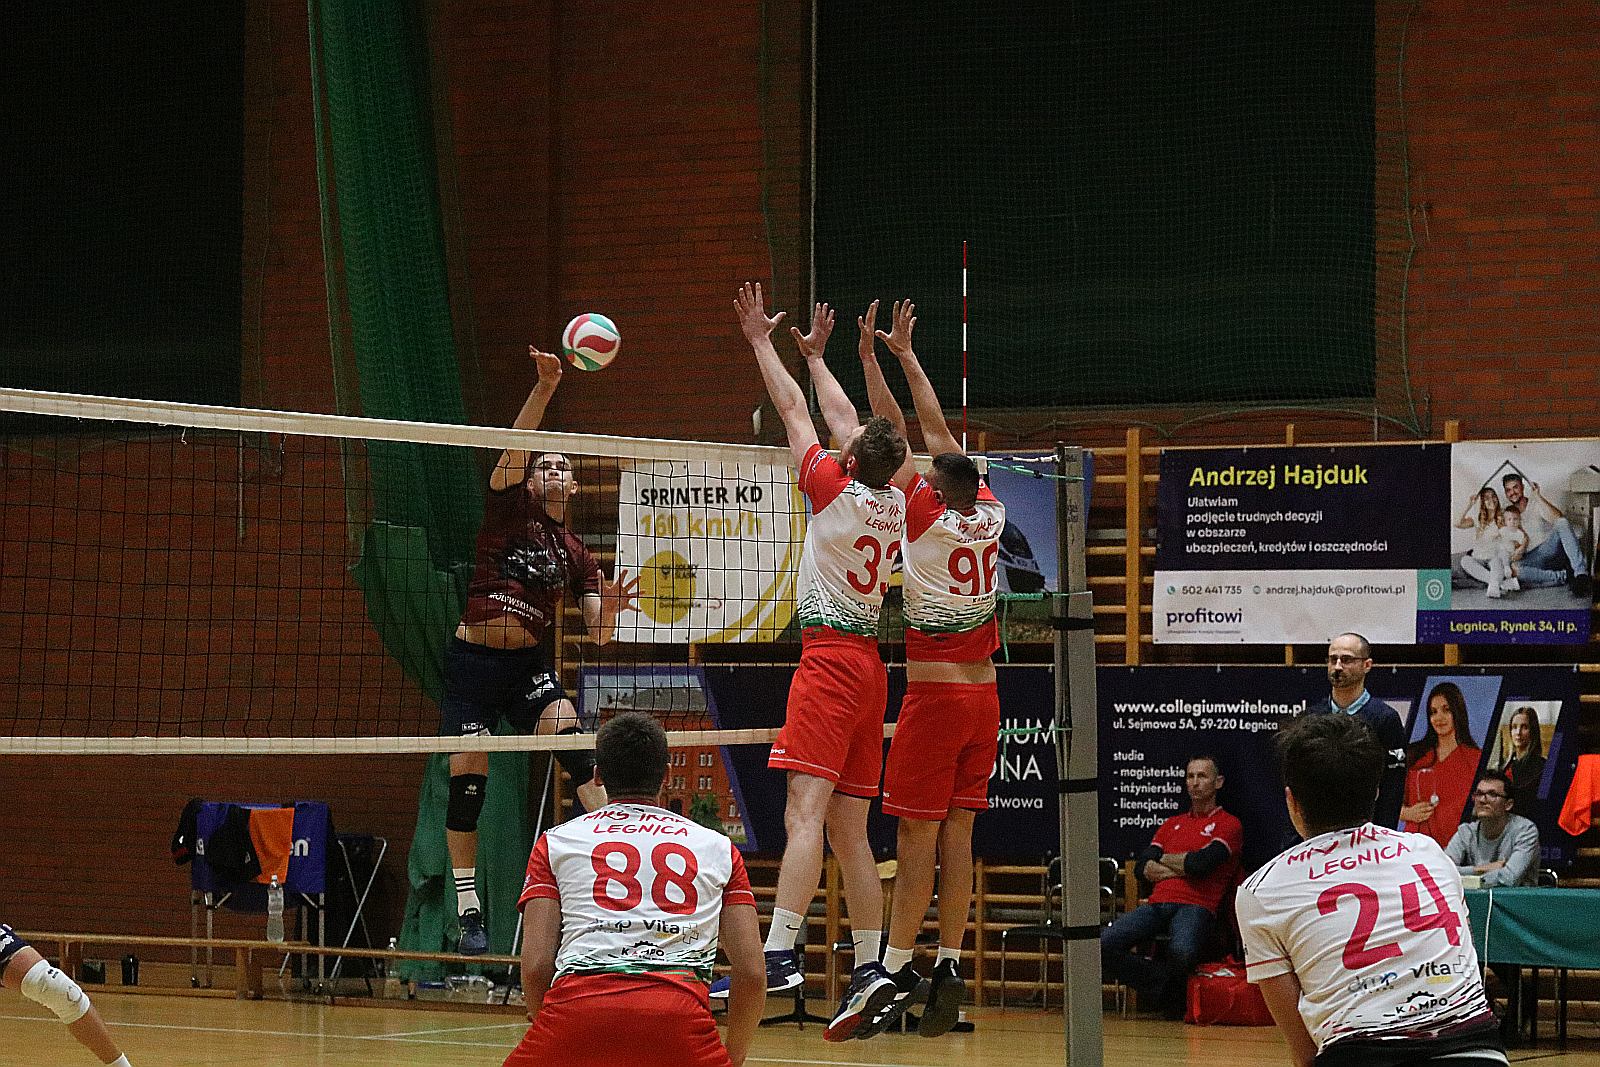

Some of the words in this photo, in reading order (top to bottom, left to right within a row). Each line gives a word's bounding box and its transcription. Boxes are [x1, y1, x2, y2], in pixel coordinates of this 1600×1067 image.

[1189, 466, 1276, 490] Andrzej
[1284, 464, 1368, 489] Hajduk
[640, 487, 729, 505] SPRINTER
[736, 486, 762, 503] KD
[641, 514, 678, 536] 160
[687, 511, 762, 536] km/h
[1186, 512, 1235, 524] podjęcie
[1237, 511, 1283, 523] trudnych
[1285, 510, 1322, 523] decyzji
[1186, 529, 1195, 537] w
[1198, 527, 1246, 537] obszarze
[1186, 541, 1258, 555] ubezpieczeń,
[1259, 541, 1306, 554] kredytów
[1314, 539, 1388, 553] oszczędności
[1182, 586, 1202, 595] 502
[1205, 586, 1222, 595] 441
[1223, 585, 1242, 595] 735
[1266, 585, 1406, 597] andrzej.hajduk@profitowi.pl
[1167, 608, 1242, 626] profitowi
[1450, 621, 1498, 633] Legnica,
[1501, 621, 1536, 633] Rynek
[1538, 621, 1555, 633] 34,
[1566, 622, 1577, 633] p.
[1114, 700, 1306, 717] www.collegiumwitelona.pl
[1113, 718, 1125, 729] ul.
[1128, 718, 1176, 731] Sejmowa
[1179, 719, 1198, 730] 5A,
[1200, 718, 1237, 730] 59-220
[1239, 718, 1278, 732] Legnica
[1113, 750, 1145, 761] studia
[1120, 767, 1186, 780] magisterskie
[1120, 782, 1182, 796] inżynierskie
[1120, 798, 1179, 812] licencjackie
[593, 823, 688, 837] LEGNICA
[1309, 842, 1411, 880] LEGNICA
[591, 841, 698, 915] 88
[1316, 863, 1462, 970] 24
[643, 919, 680, 934] Vita
[1396, 997, 1448, 1014] KAMPO
